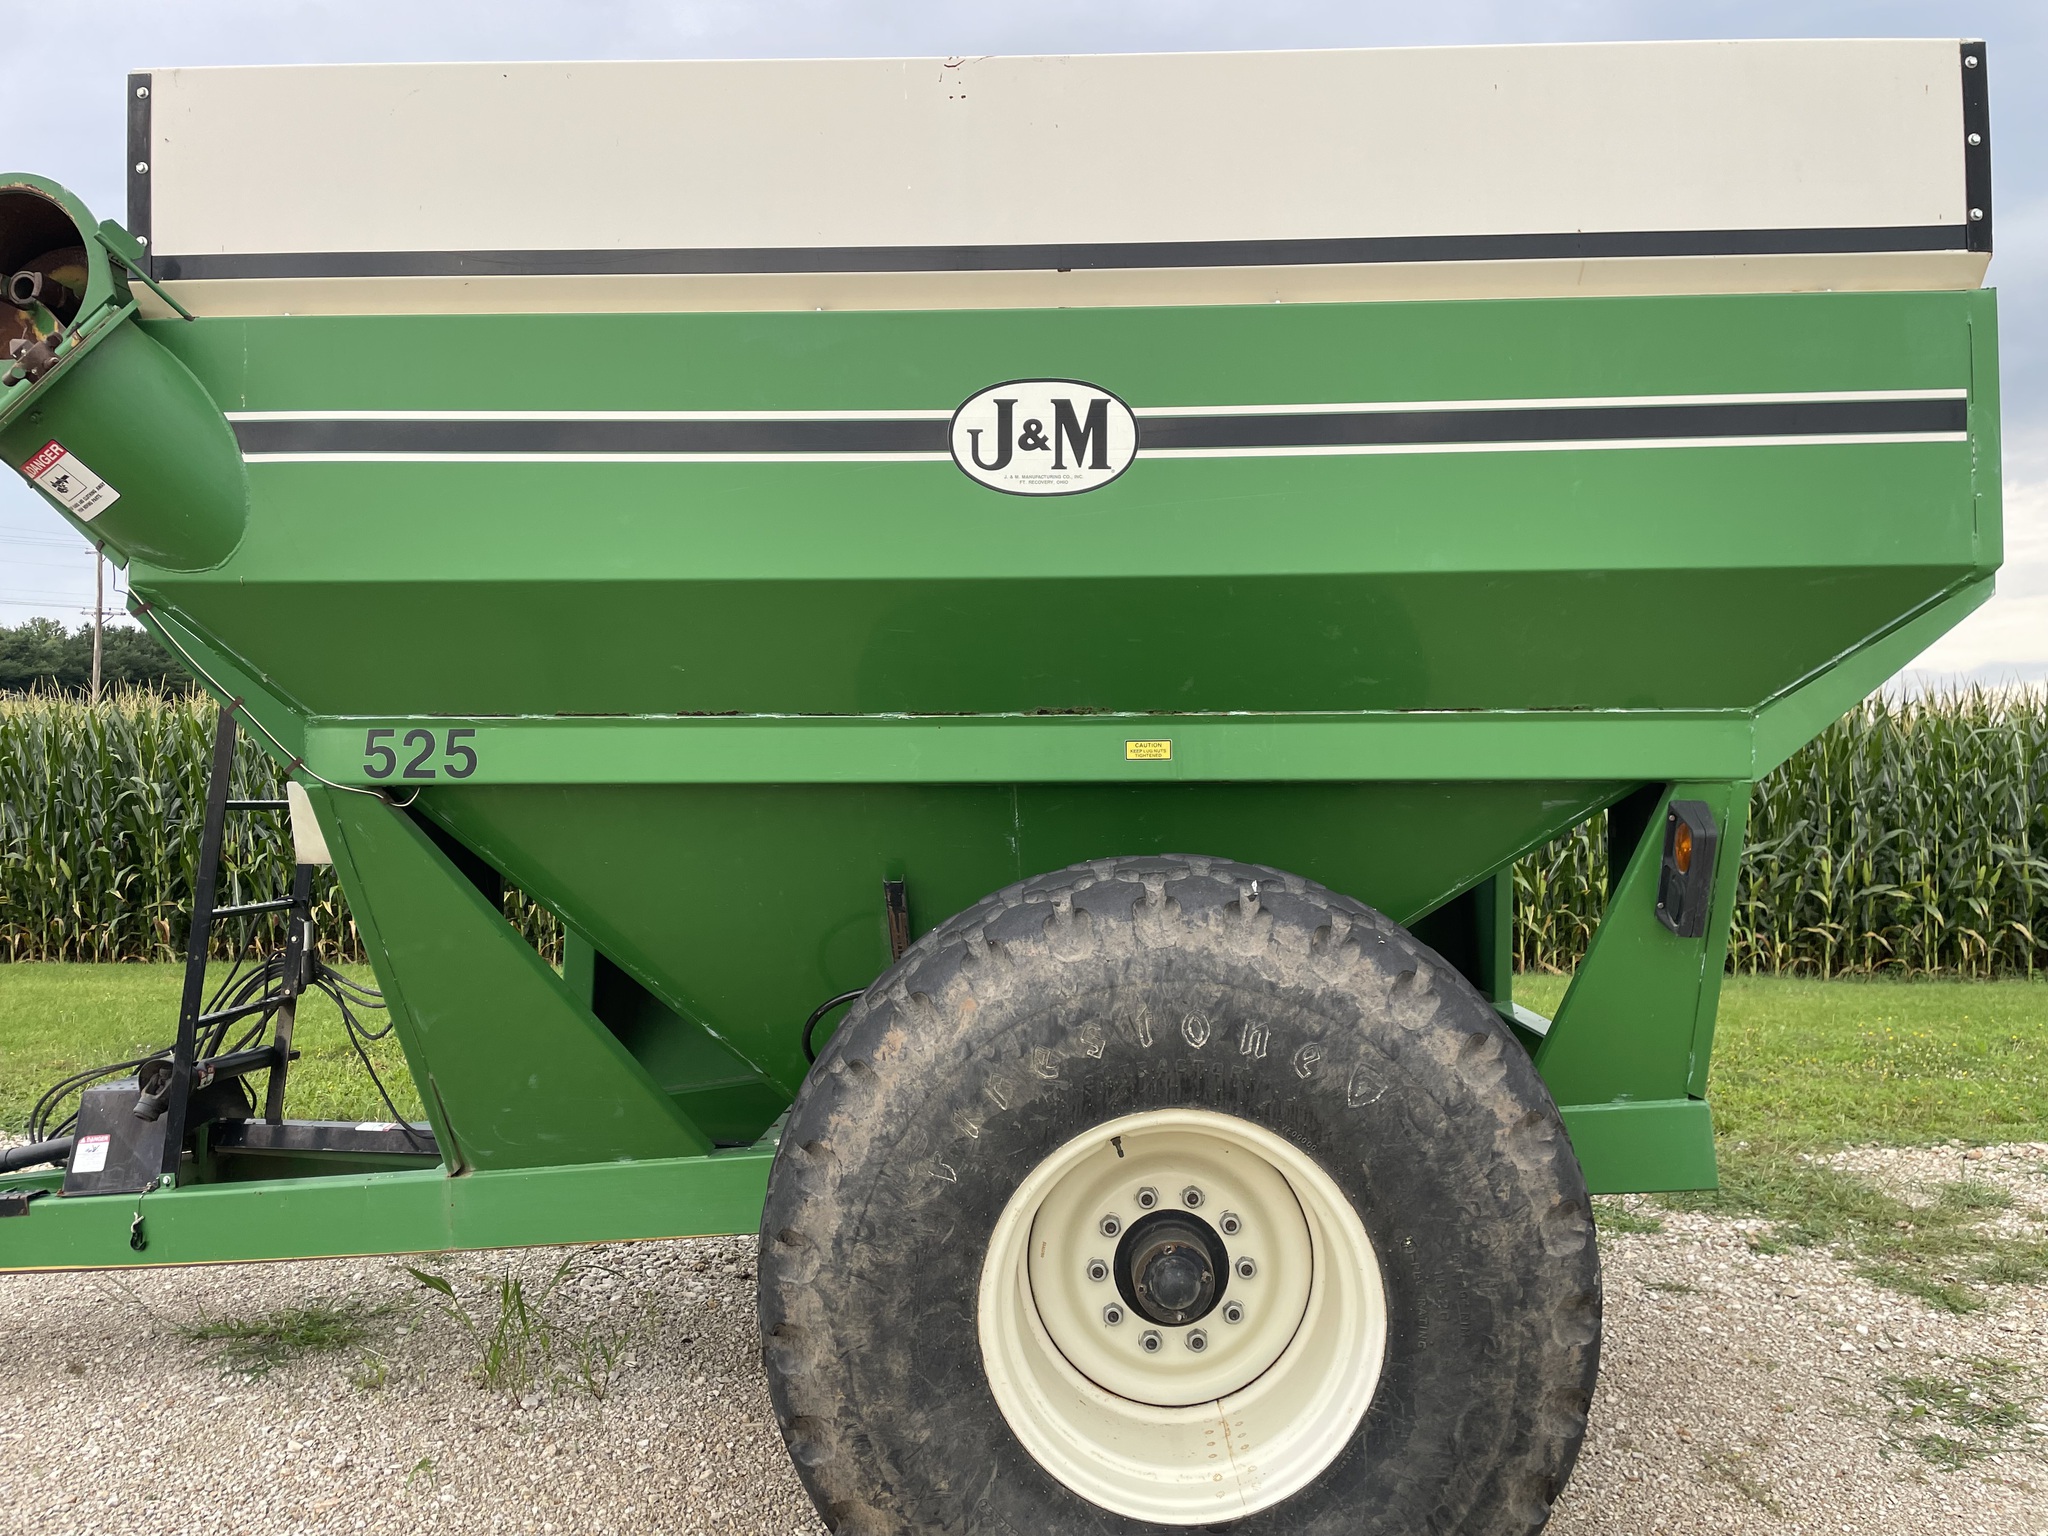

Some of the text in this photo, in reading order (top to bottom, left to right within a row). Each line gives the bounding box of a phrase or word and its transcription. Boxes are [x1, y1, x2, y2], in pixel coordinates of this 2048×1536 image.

[26, 444, 64, 475] DANGER
[966, 398, 1111, 471] J&M
[363, 729, 478, 779] 525
[1416, 1297, 1429, 1349] RATING
